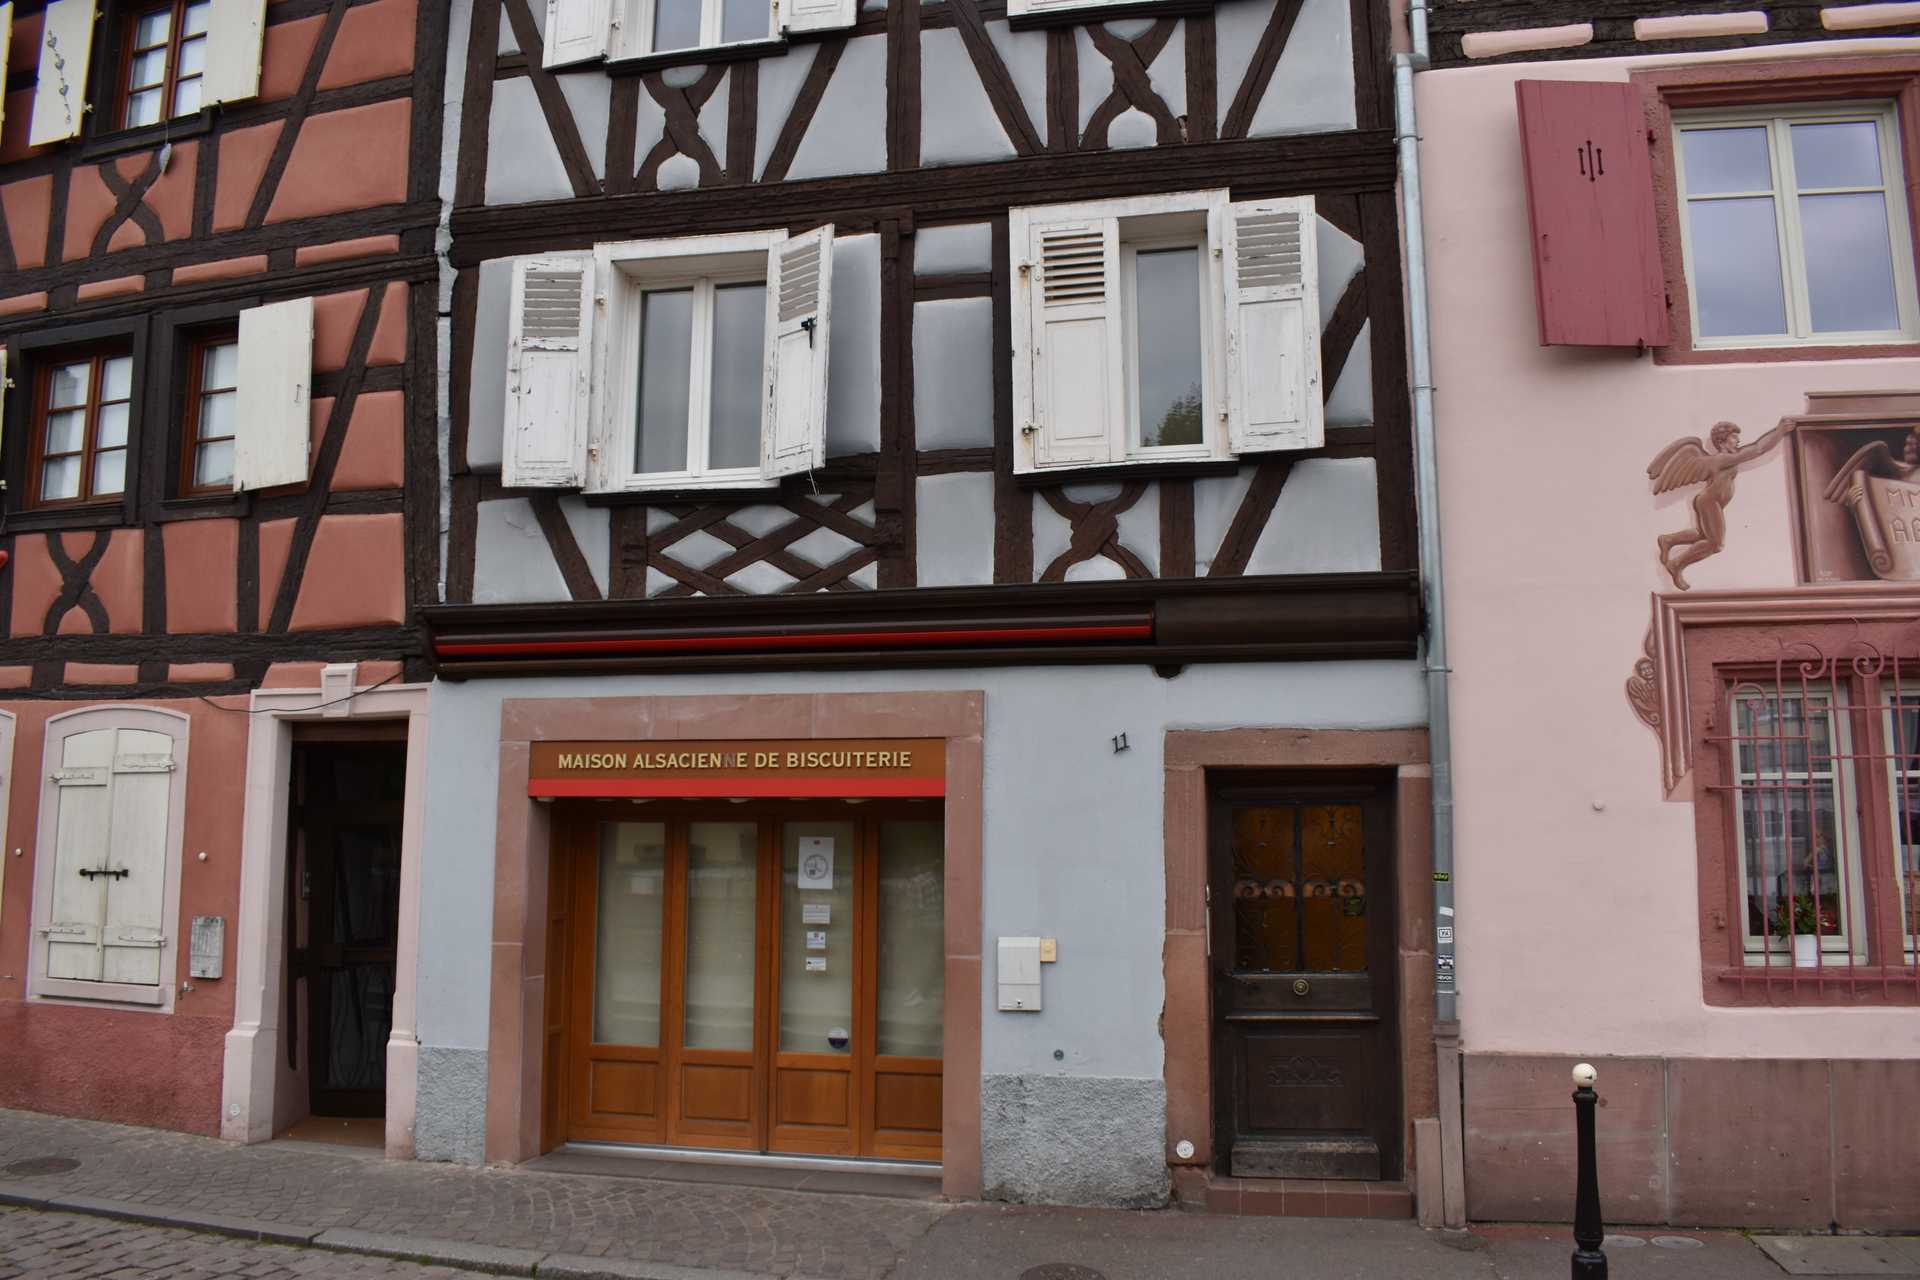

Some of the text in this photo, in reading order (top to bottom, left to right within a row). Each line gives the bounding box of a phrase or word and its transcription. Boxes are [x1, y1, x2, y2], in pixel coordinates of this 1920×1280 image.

[1112, 732, 1130, 754] 11
[558, 751, 912, 769] MAISON ALSACIENNE DE BISCUITERIE
